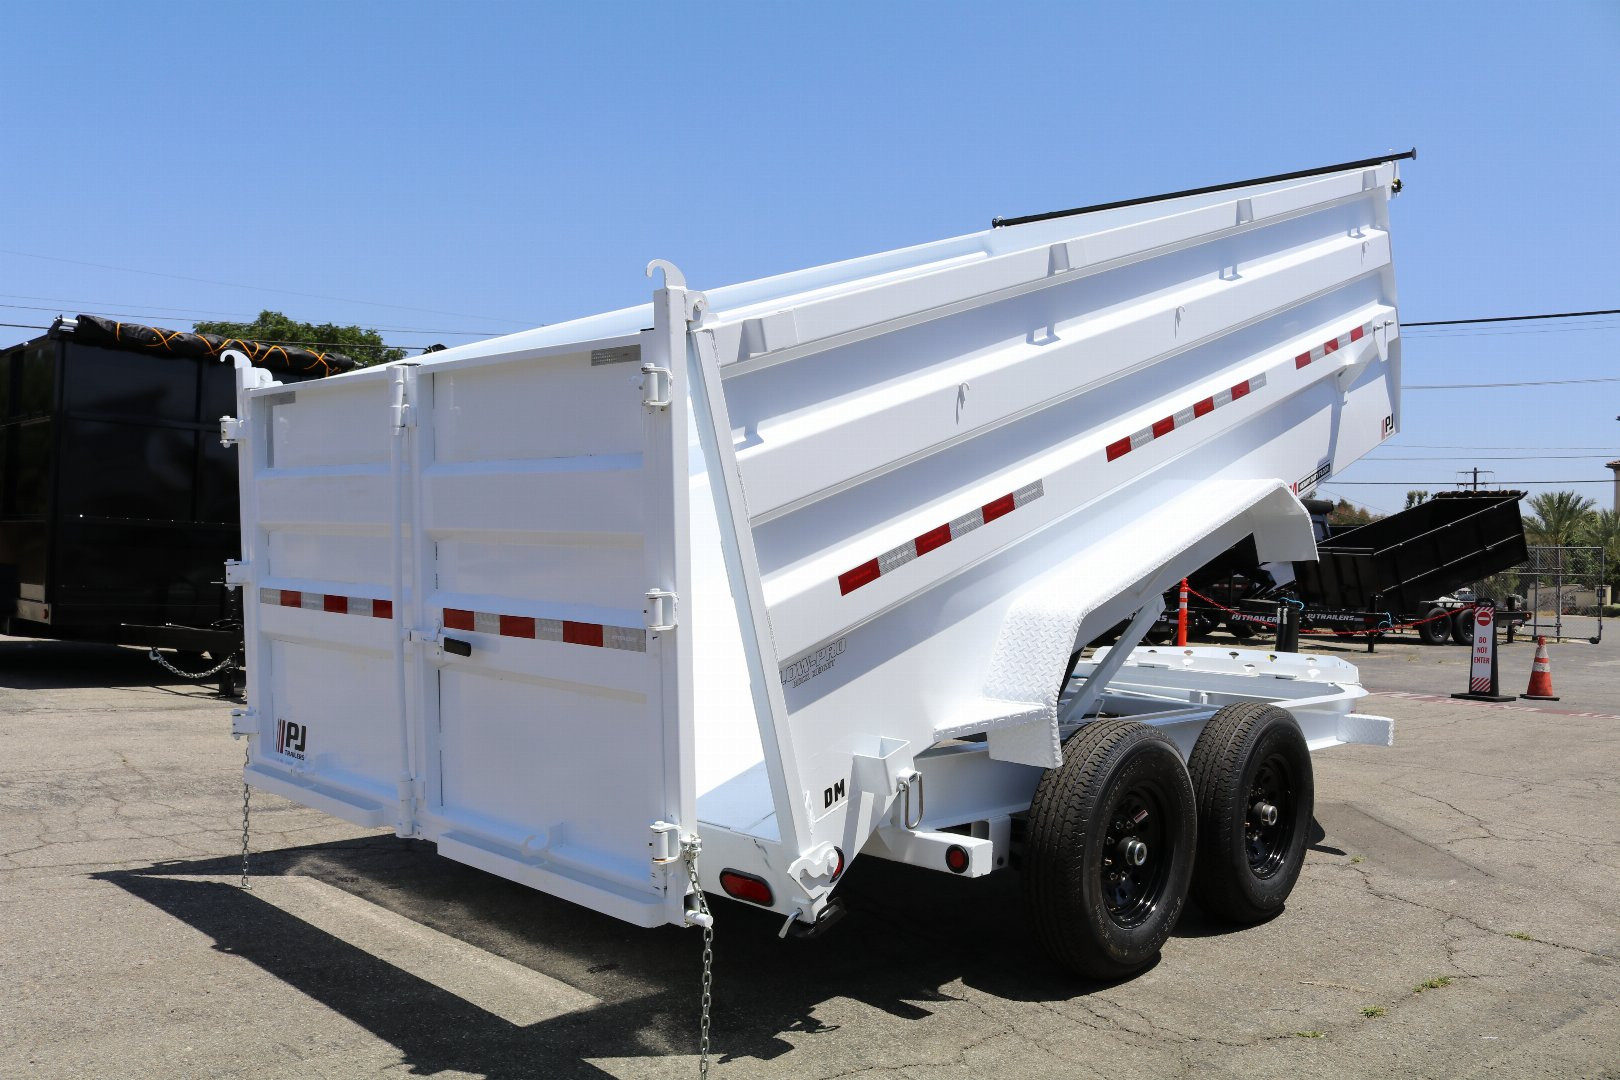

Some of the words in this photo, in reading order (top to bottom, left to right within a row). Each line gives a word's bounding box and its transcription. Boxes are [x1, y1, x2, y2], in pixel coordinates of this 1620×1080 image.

[1385, 412, 1394, 433] PJ
[1242, 614, 1280, 623] TRAILER
[285, 722, 306, 752] PJ
[823, 778, 845, 809] DM
